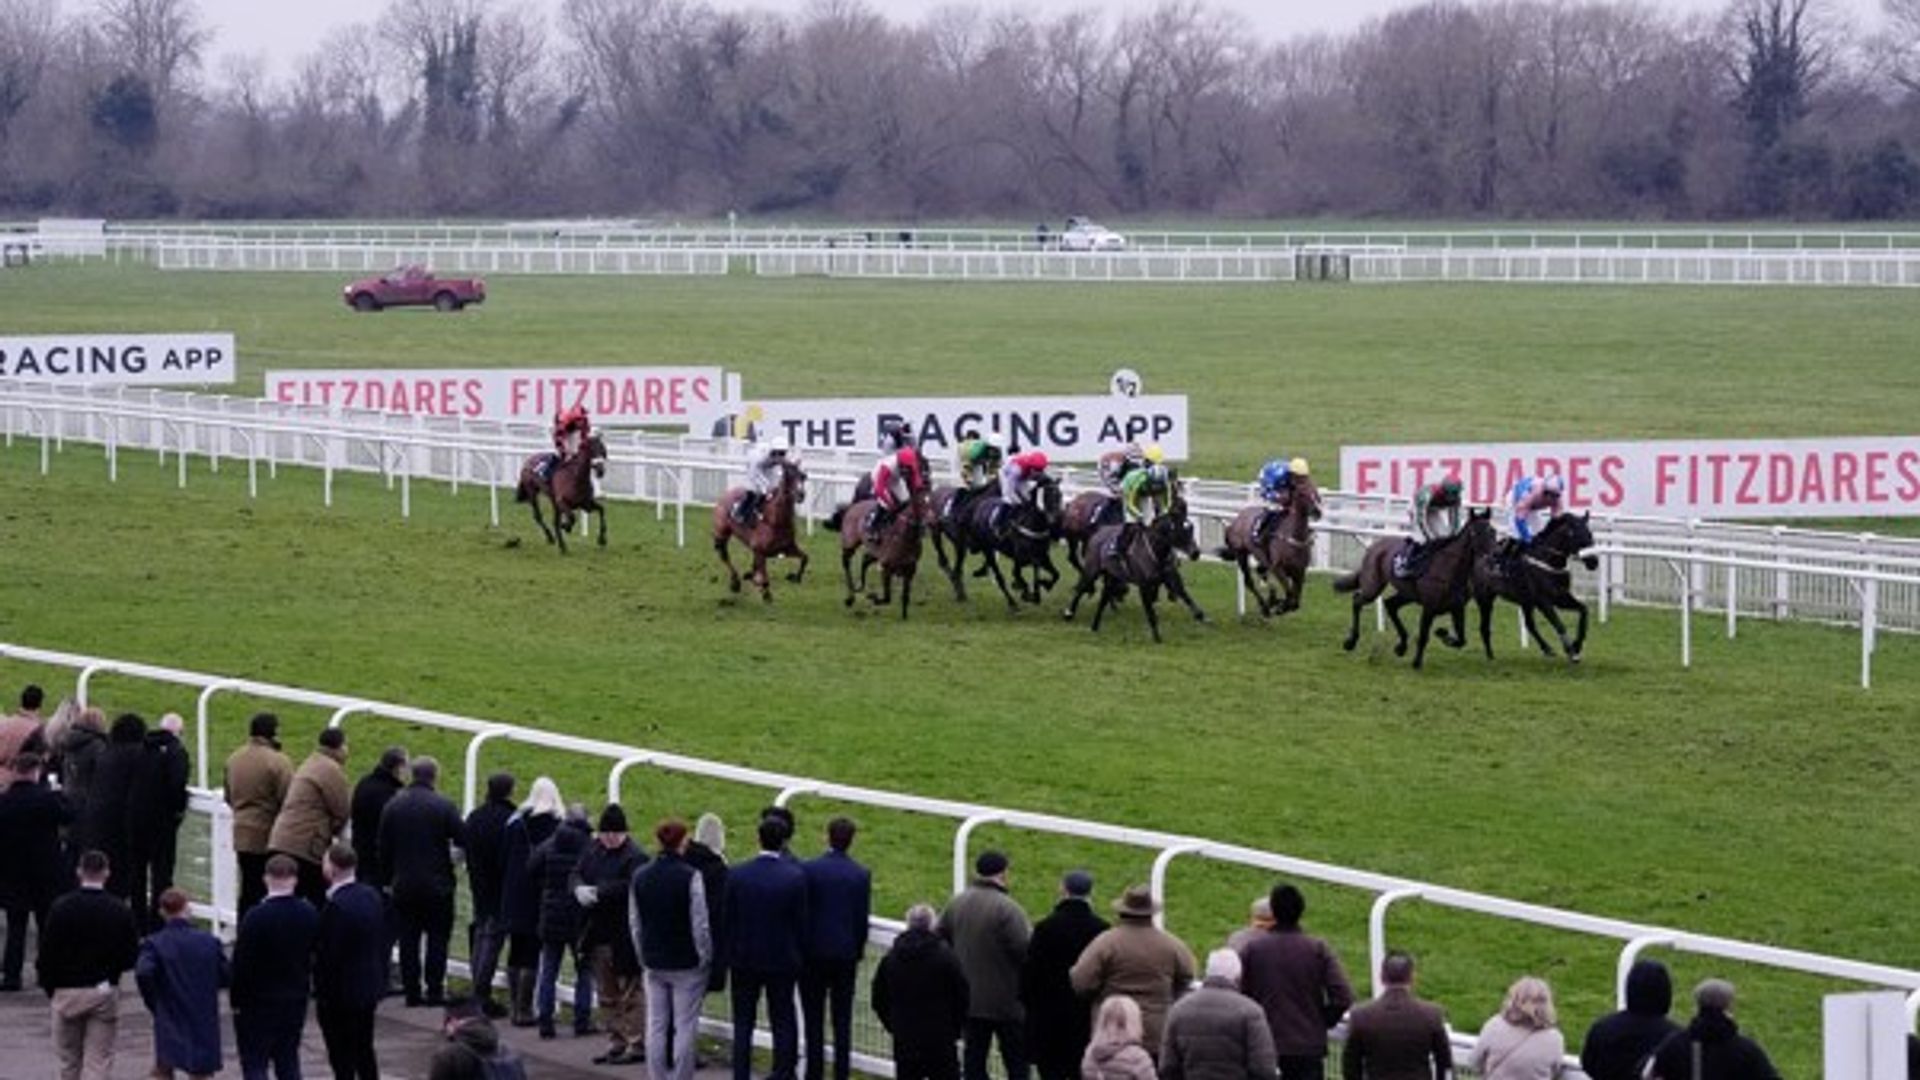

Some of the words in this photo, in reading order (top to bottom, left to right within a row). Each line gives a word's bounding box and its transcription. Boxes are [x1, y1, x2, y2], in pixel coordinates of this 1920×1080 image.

[0, 346, 147, 376] ACING
[162, 348, 222, 370] APP
[781, 419, 856, 447] THE
[1098, 414, 1172, 443] APP
[1655, 451, 1920, 505] FITZDARES
